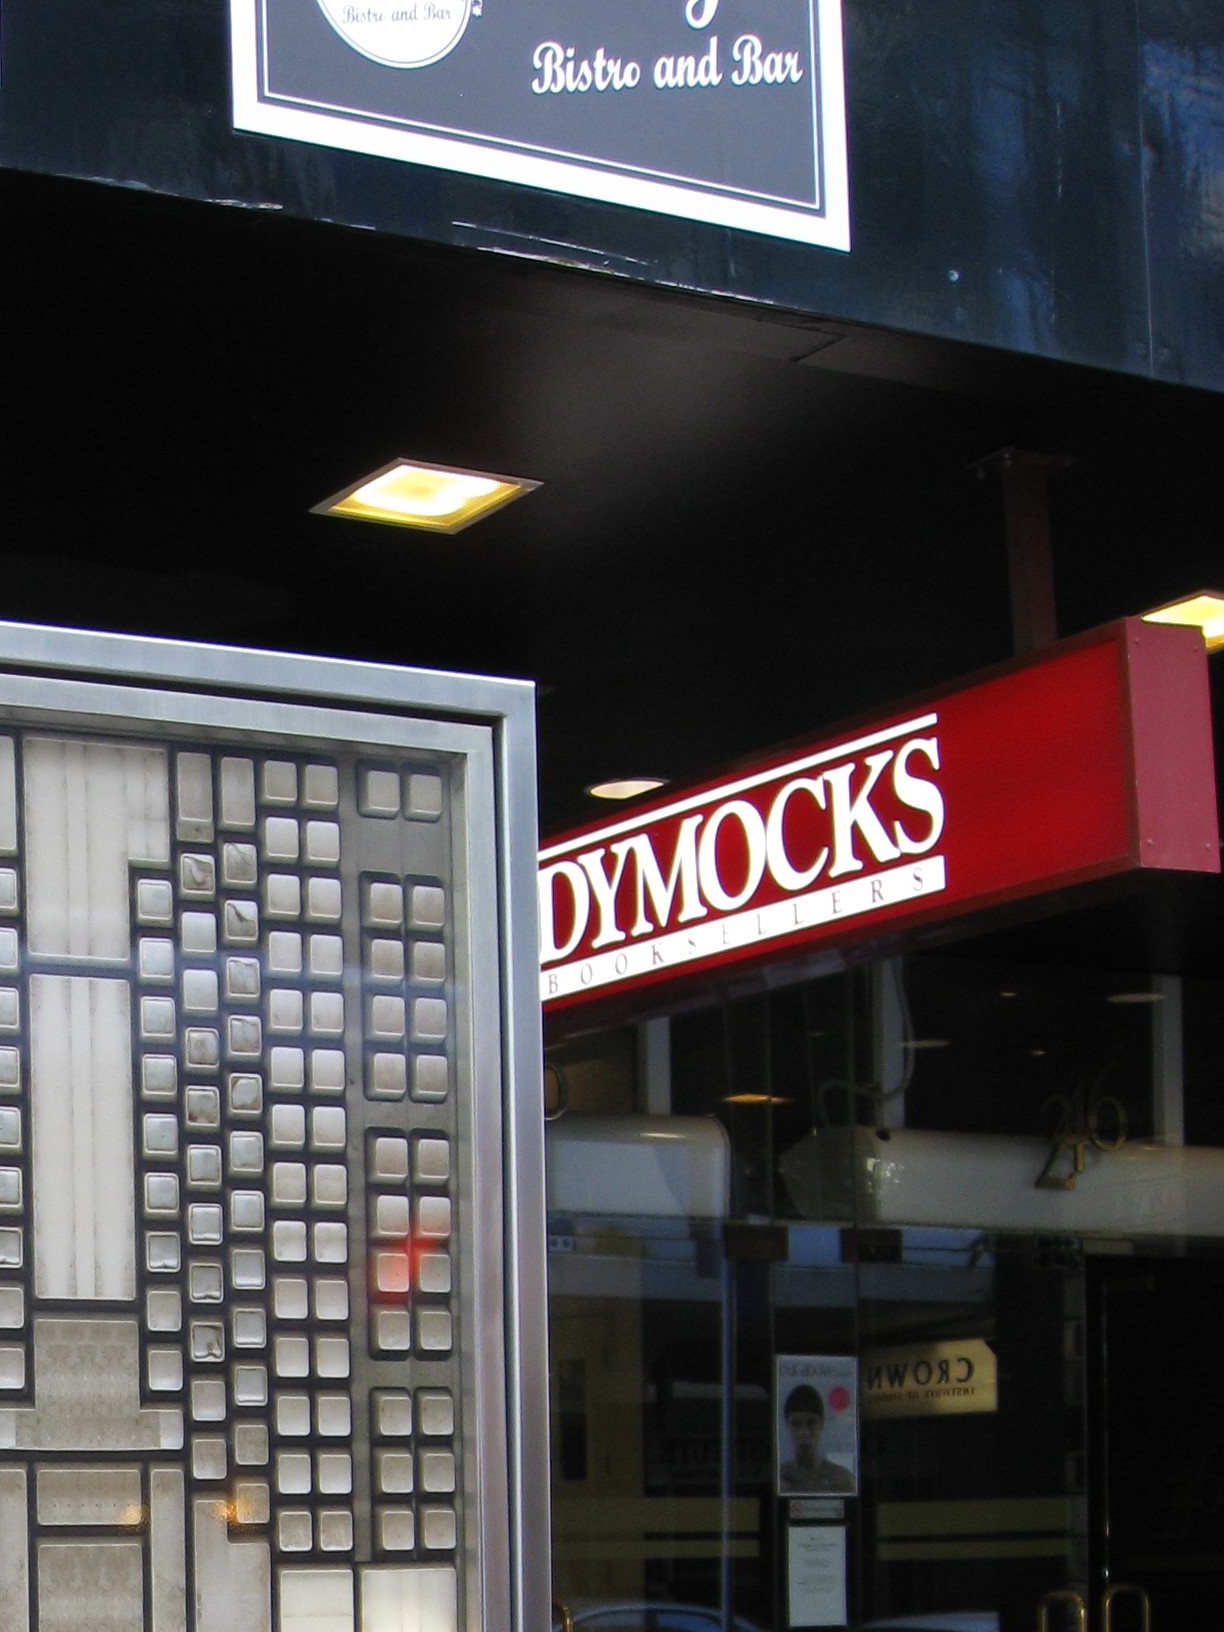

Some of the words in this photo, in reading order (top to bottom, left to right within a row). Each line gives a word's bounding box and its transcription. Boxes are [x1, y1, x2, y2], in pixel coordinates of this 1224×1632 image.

[391, 4, 419, 22] and
[423, 3, 452, 21] Bar
[531, 41, 641, 94] Bistro
[653, 35, 723, 89] and
[731, 33, 803, 86] Bar
[539, 737, 945, 961] DYMOCKS
[548, 866, 926, 995] BOOKSELLERS
